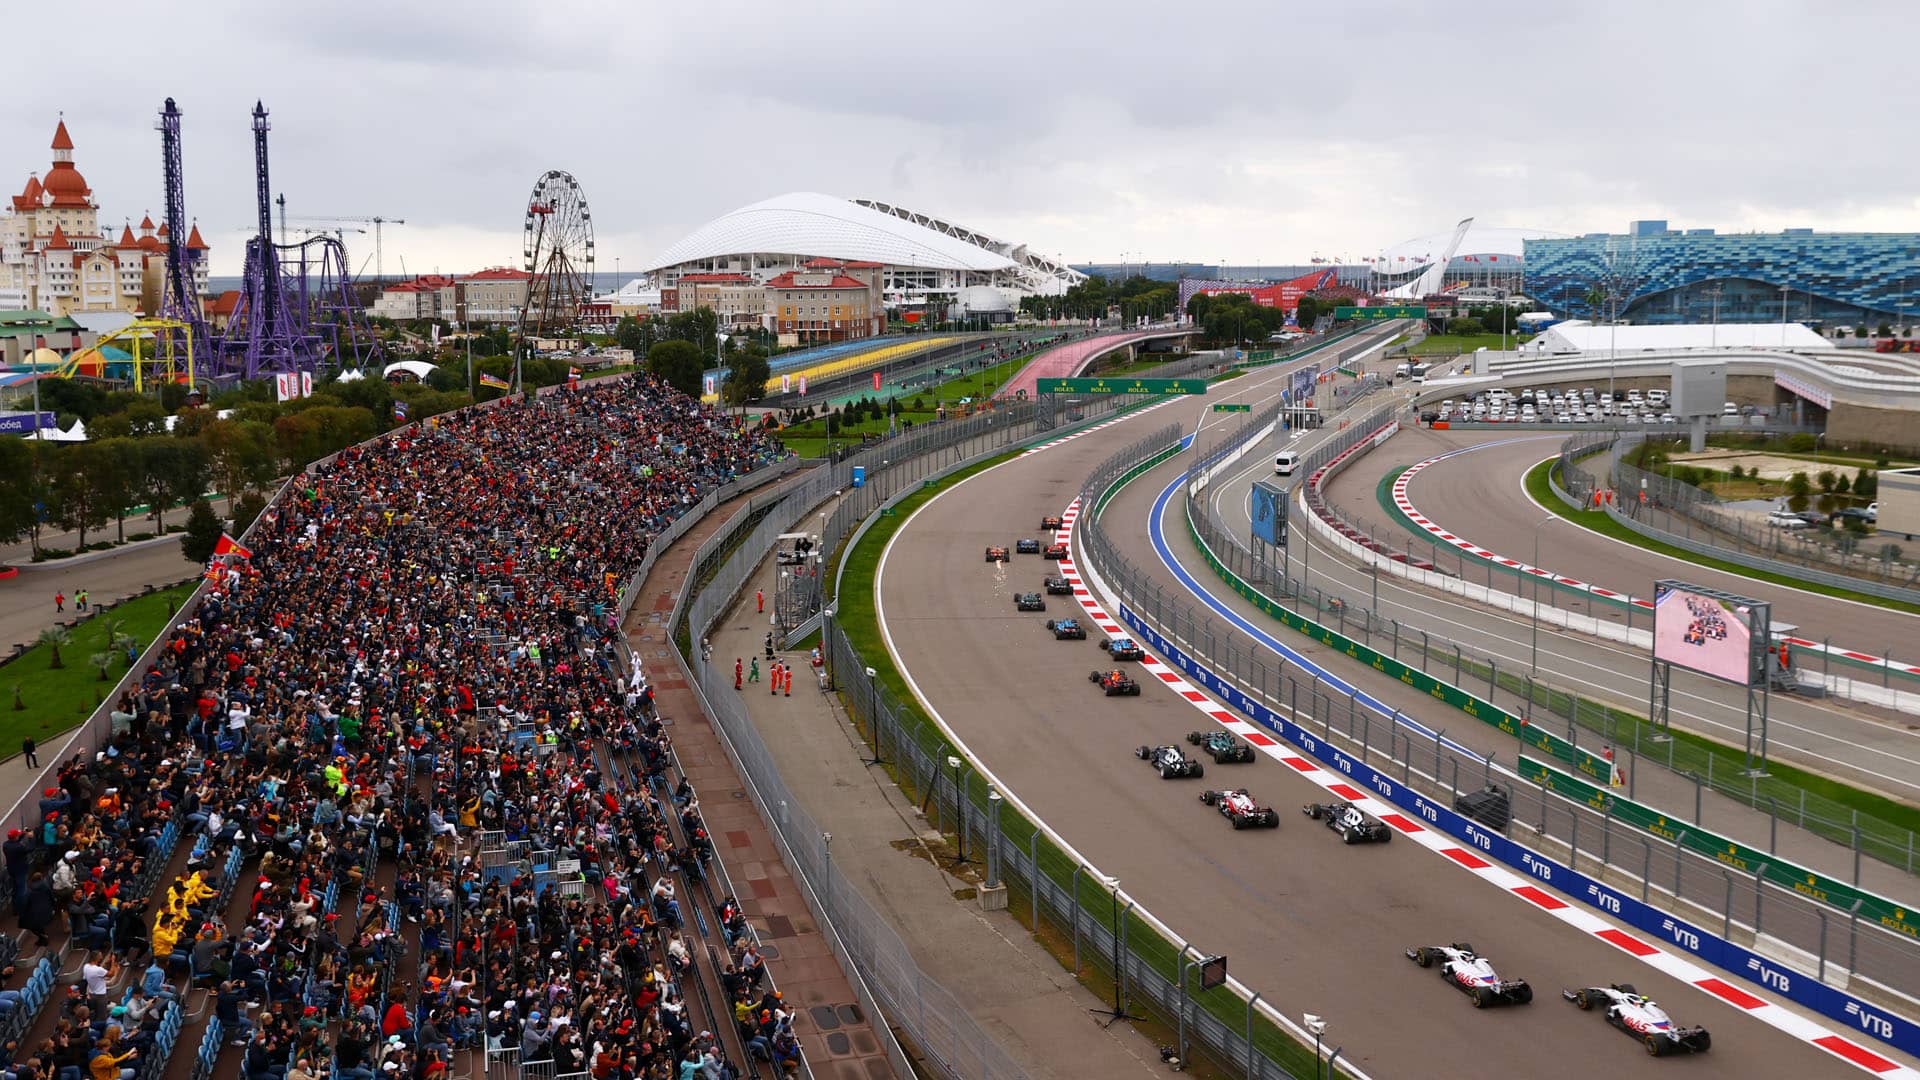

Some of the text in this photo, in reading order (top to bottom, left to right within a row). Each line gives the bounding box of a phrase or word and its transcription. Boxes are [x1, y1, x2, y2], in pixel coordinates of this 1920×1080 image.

[1463, 704, 1478, 716] ROLEX
[1499, 722, 1514, 735] ROLEX
[1246, 703, 1254, 715] VTB
[1273, 720, 1283, 733] VTB
[1304, 738, 1315, 752] VTB
[1339, 758, 1351, 773] VTB
[1378, 781, 1391, 796] VTB
[1422, 806, 1437, 822] VTB
[1473, 831, 1490, 850] VTB
[1530, 859, 1551, 880] VTB
[1598, 892, 1620, 913] VTB
[1673, 927, 1699, 950] VTB
[1760, 966, 1790, 992] VTB
[1859, 1010, 1893, 1038] VTB
[1649, 824, 1675, 840] ROLEX
[1717, 851, 1747, 870] ROLEX
[1794, 882, 1827, 901] ROLEX
[1881, 916, 1917, 937] ROLEX
